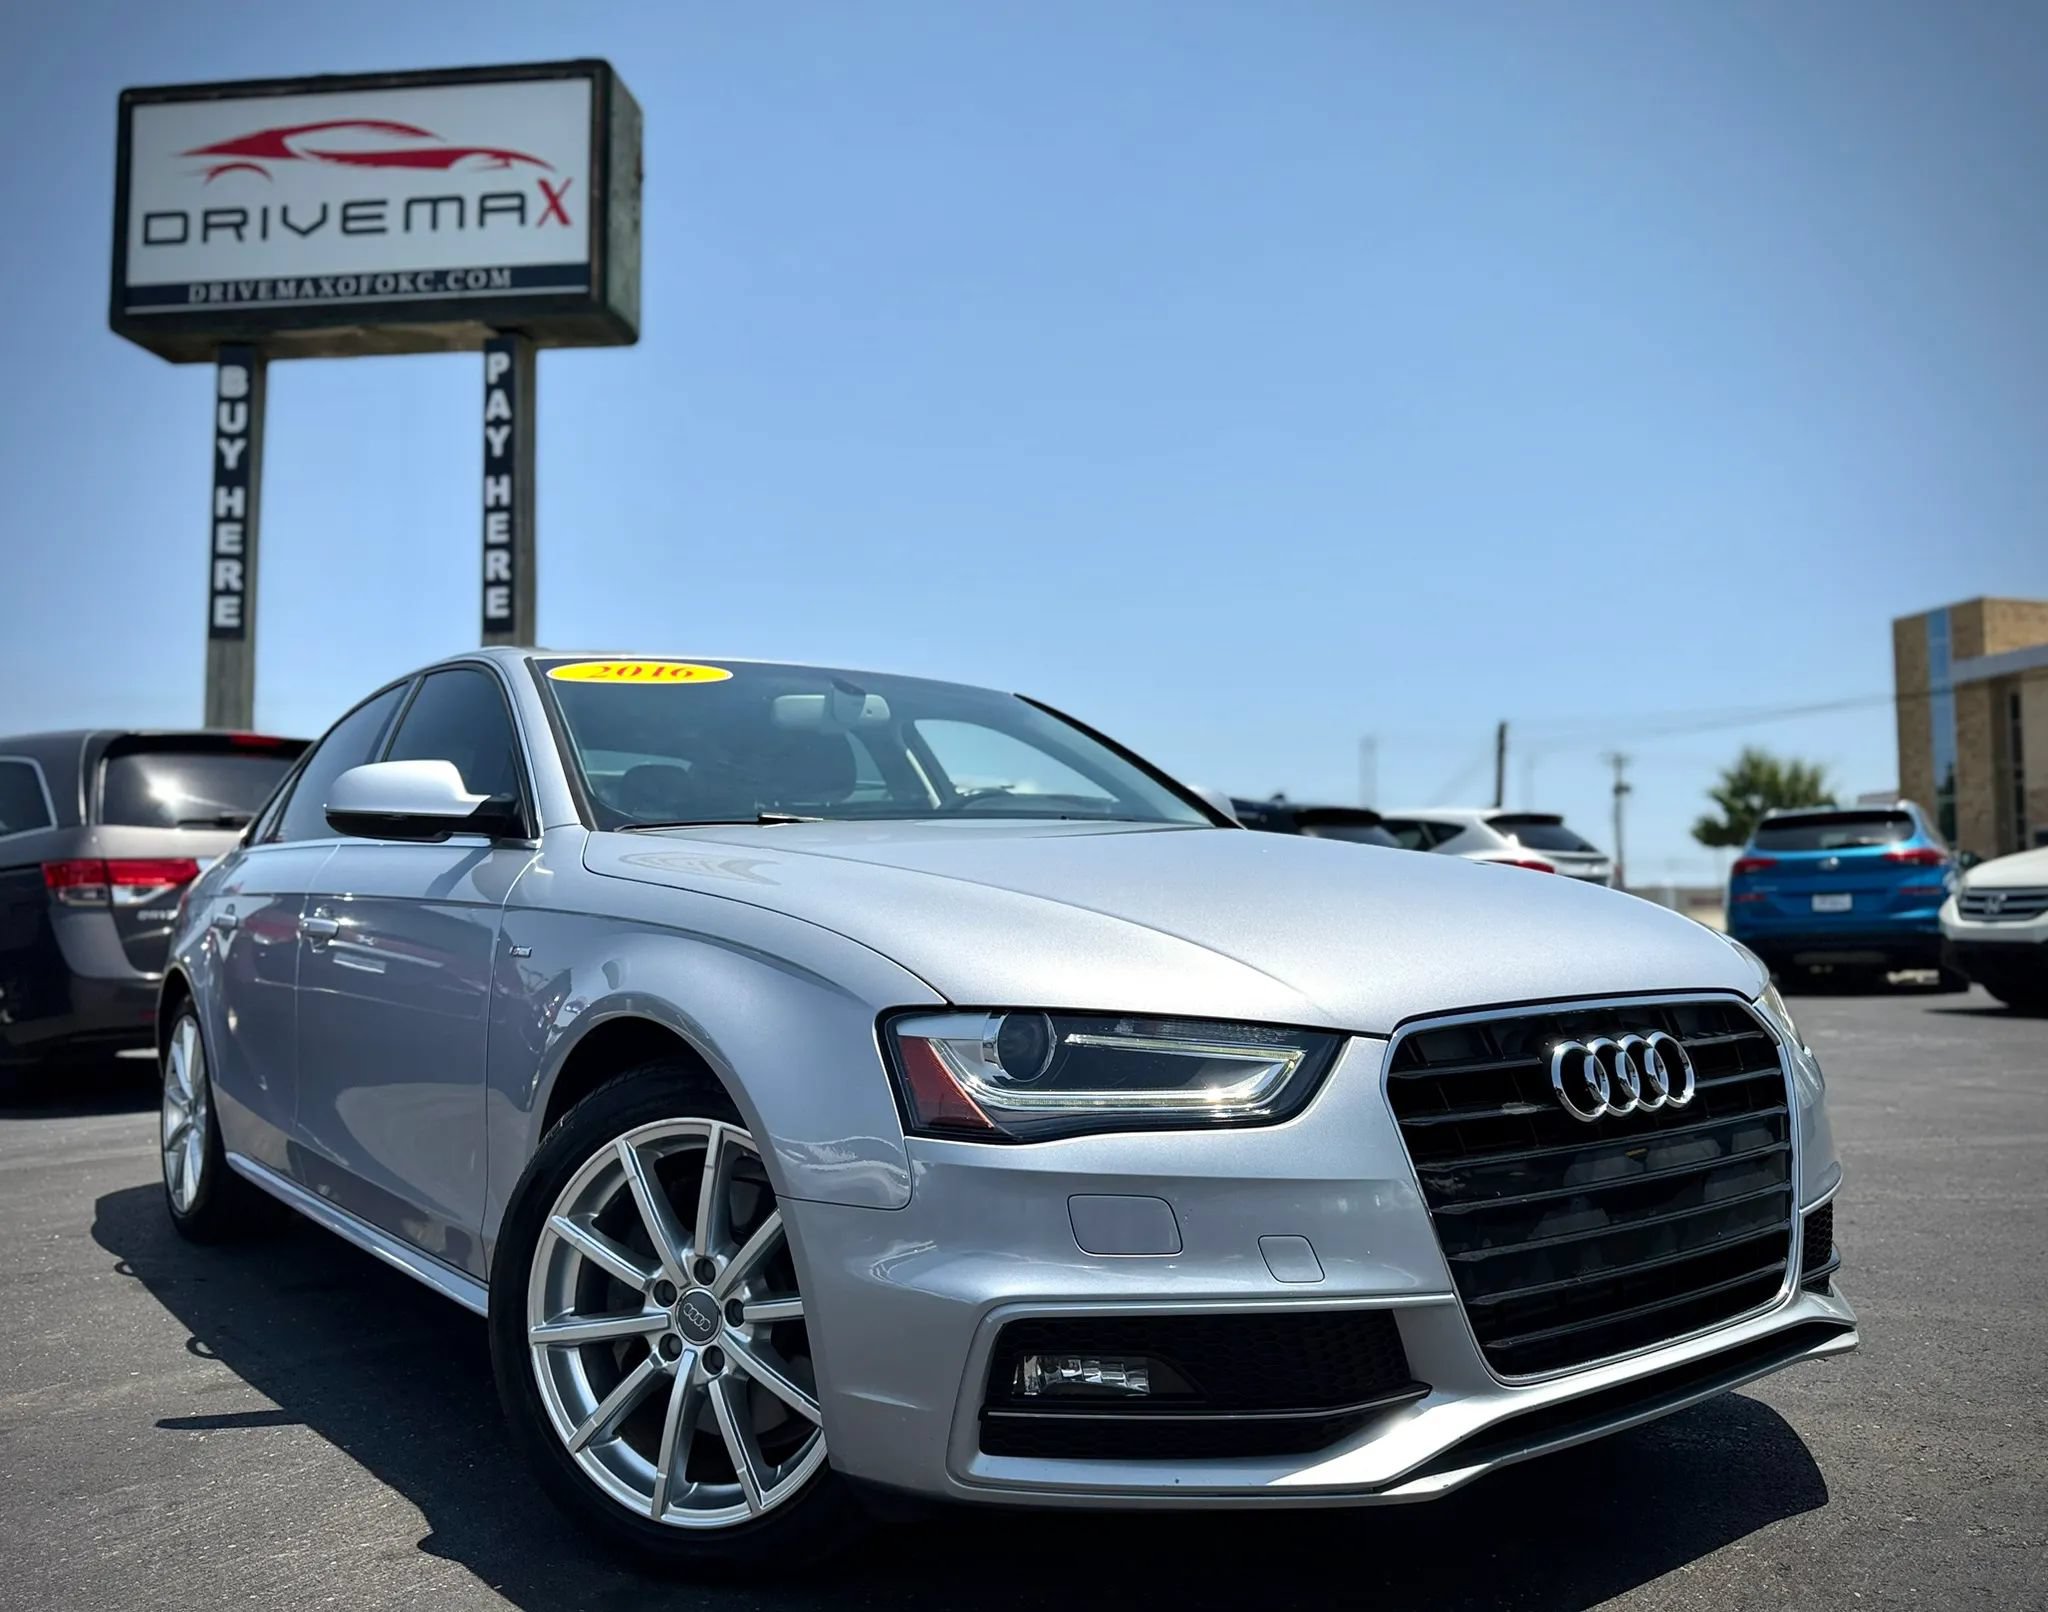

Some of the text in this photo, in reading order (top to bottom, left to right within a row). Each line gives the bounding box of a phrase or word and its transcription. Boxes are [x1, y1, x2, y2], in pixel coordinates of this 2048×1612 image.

[142, 176, 573, 247] DRIVEMAX
[187, 267, 512, 304] DRIVEMAXOFOKC.COM
[213, 365, 249, 629] BUY HERE
[485, 352, 512, 619] PAY HERE
[586, 666, 694, 679] 2016
